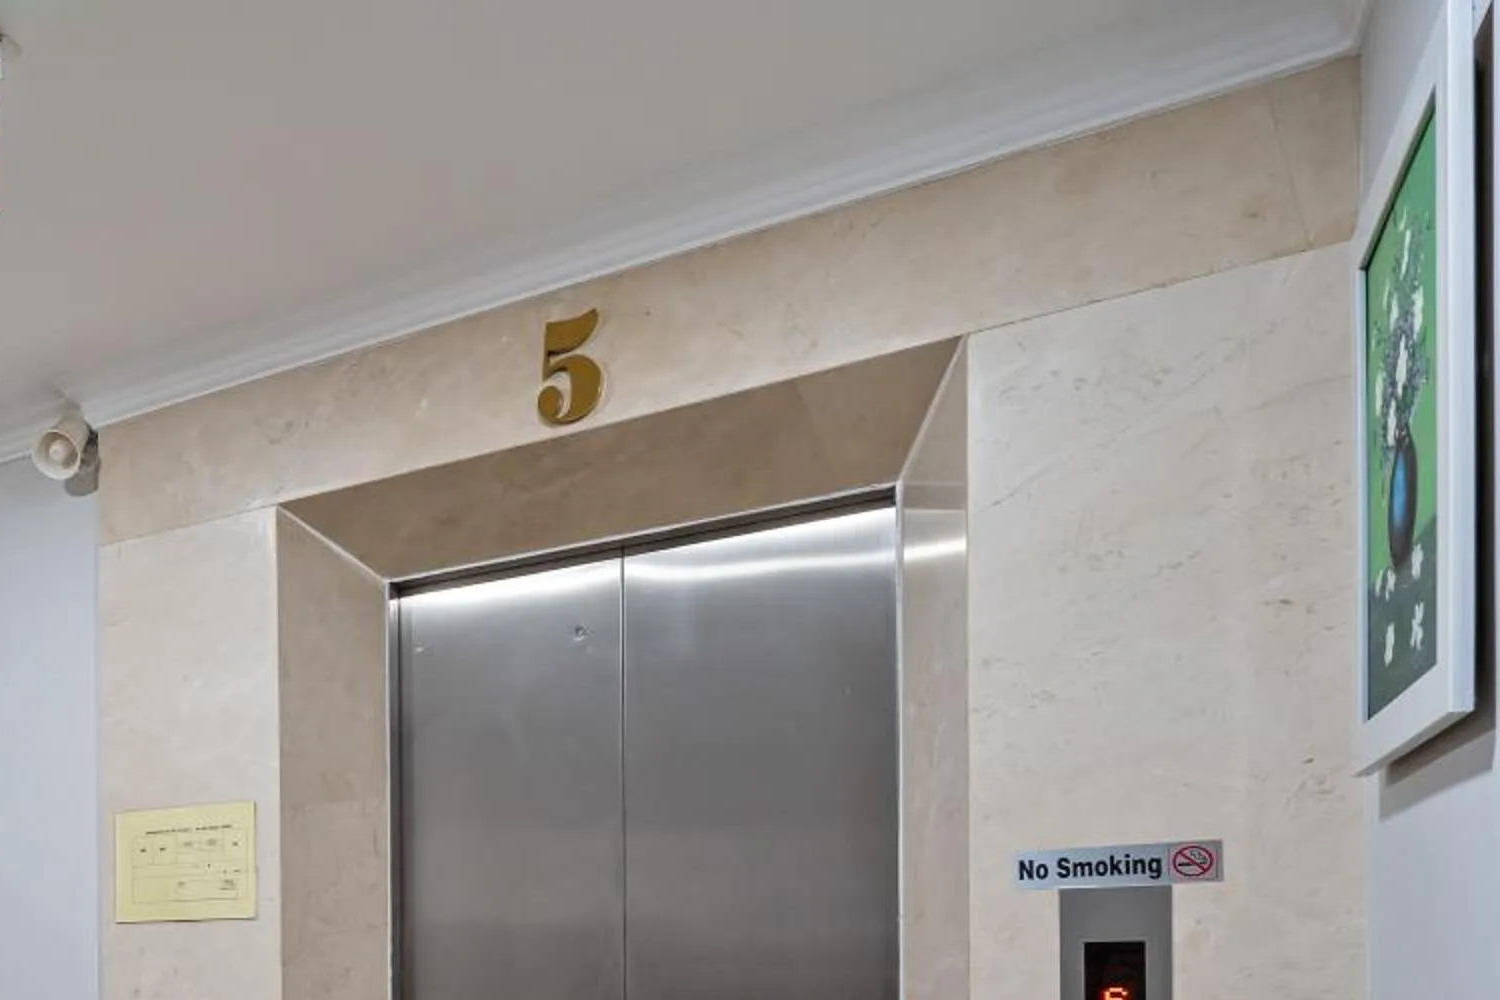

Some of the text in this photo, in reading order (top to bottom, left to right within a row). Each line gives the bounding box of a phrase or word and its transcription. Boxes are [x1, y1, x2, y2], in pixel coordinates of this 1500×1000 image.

[537, 307, 602, 427] 5
[1018, 853, 1163, 881] No Smoking
